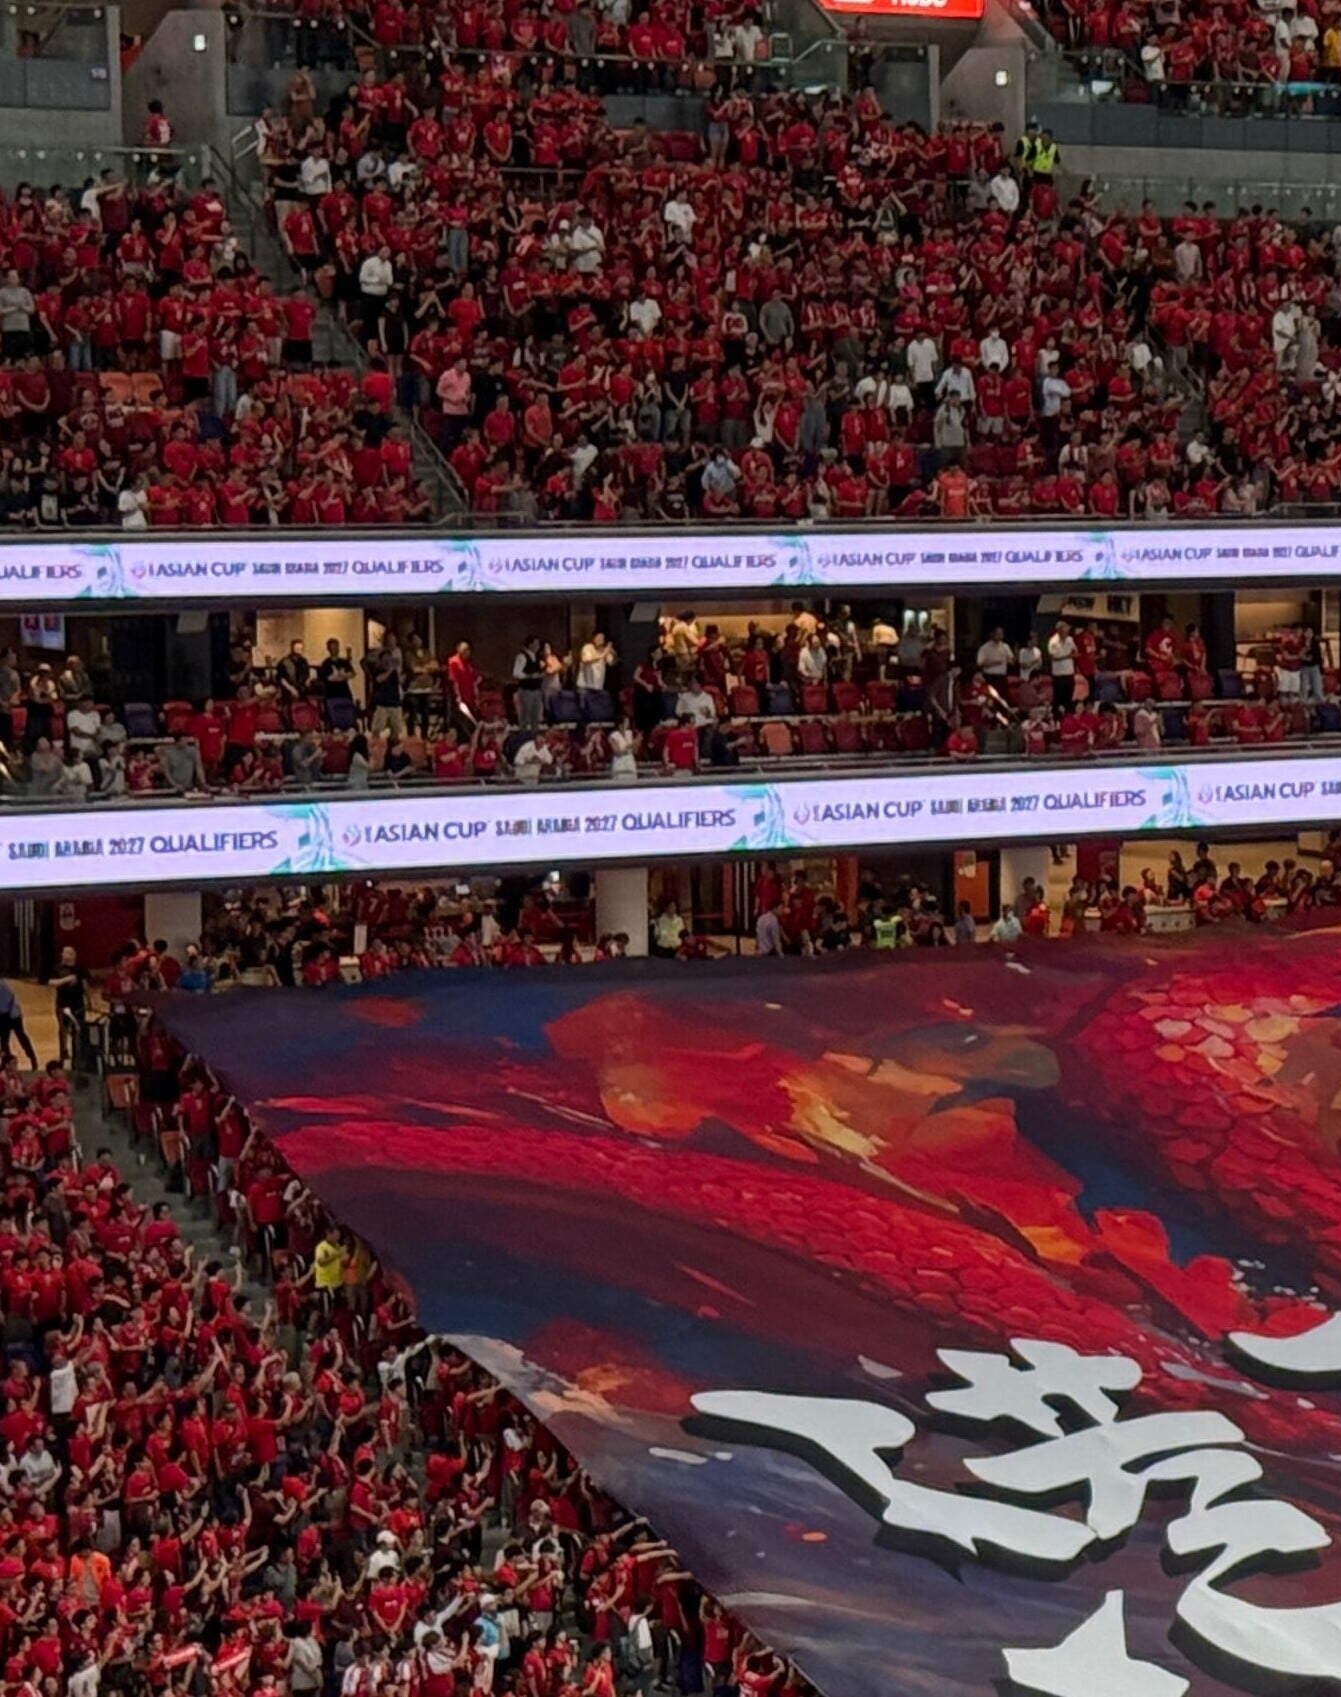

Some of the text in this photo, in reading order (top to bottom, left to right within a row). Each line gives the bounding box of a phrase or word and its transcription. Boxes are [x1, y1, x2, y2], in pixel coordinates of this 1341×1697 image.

[153, 562, 208, 578] ASIAN
[209, 561, 248, 578] CUP
[510, 557, 560, 573] ASIAN
[561, 556, 595, 573] CUP
[838, 552, 884, 568] ASIAN
[884, 551, 915, 567] CUP
[1223, 783, 1276, 803] ASIAN
[1278, 781, 1315, 800] CUP
[820, 801, 880, 822] ASIAN
[882, 800, 923, 819] CUP
[1009, 794, 1040, 813] 2027
[1042, 789, 1147, 811] QUALIFIERS
[372, 822, 440, 843] ASIAN
[442, 820, 487, 840] CUP
[584, 814, 618, 834] 2027
[620, 808, 736, 832] QUALIFIERS
[107, 836, 146, 857] 2027
[149, 830, 279, 854] QUALIFIERS
